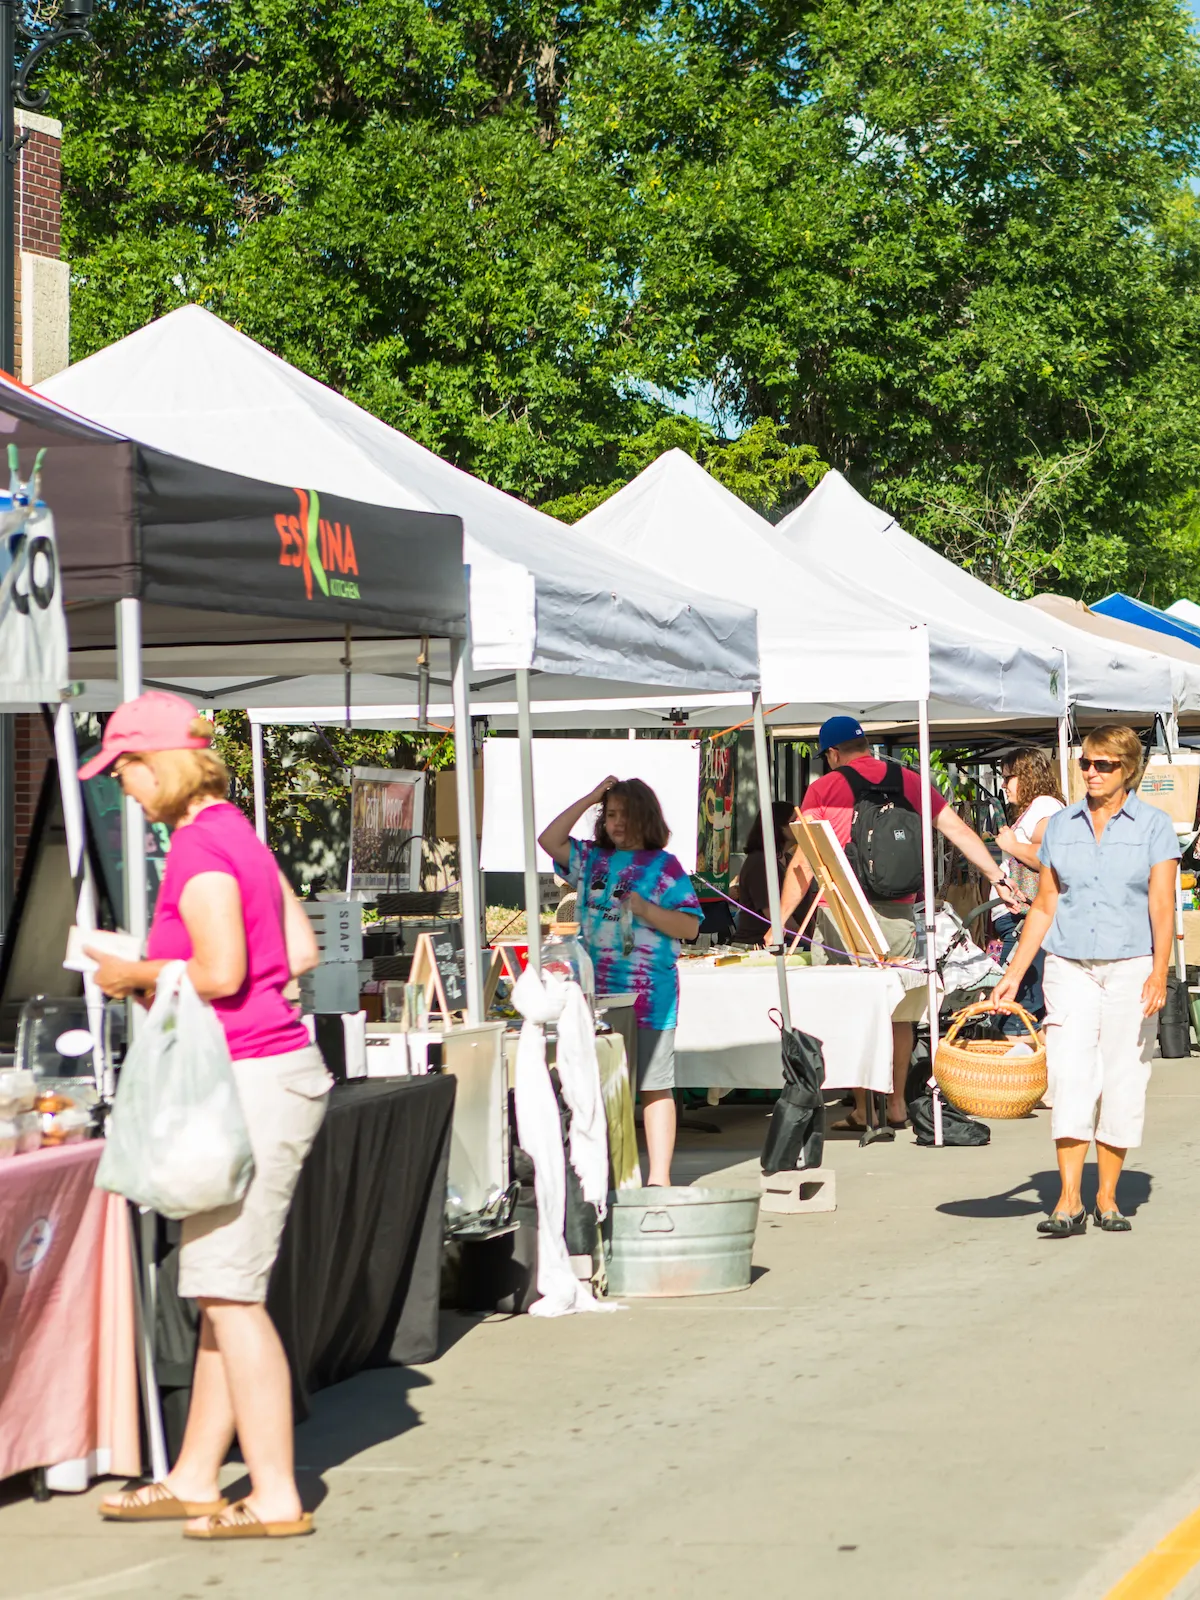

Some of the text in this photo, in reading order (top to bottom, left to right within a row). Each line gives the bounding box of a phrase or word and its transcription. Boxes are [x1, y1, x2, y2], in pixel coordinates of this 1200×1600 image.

[329, 578, 361, 599] KITCHEN
[602, 912, 620, 922] Poi
[339, 910, 350, 952] SOAP
